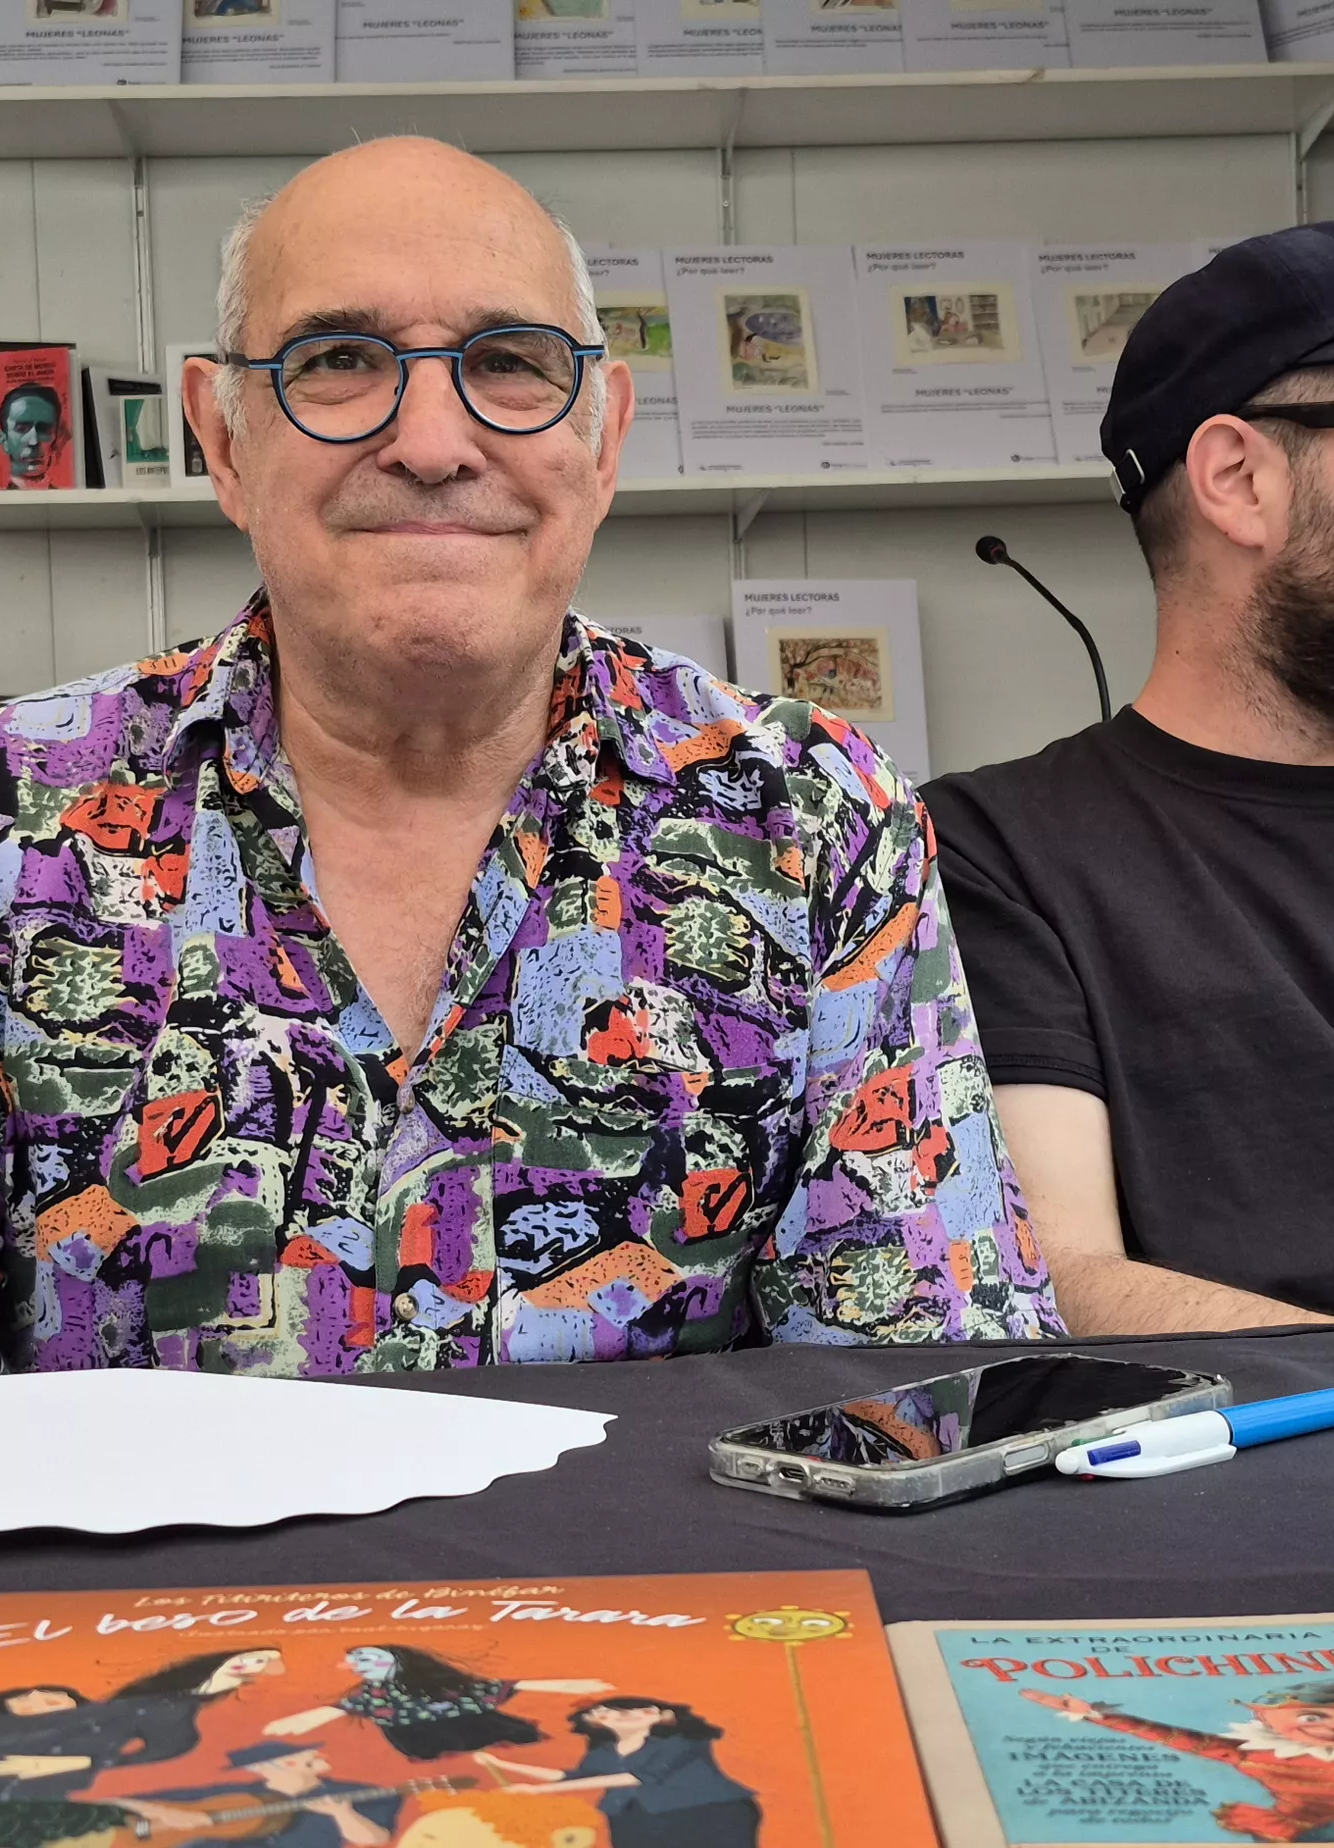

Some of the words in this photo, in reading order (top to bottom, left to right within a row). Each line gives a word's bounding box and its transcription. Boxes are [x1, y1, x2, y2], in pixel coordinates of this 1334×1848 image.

[201, 1589, 370, 1609] Titiriteros
[375, 1588, 414, 1602] de
[96, 1606, 259, 1636] beso
[283, 1600, 372, 1623] de
[391, 1599, 468, 1621] la
[490, 1599, 708, 1629] Tarara
[971, 1635, 1011, 1645] LA
[1026, 1631, 1322, 1645] EXTRAORDINARIA
[1091, 1645, 1132, 1653] DE
[1009, 1751, 1181, 1762] IMAGENES
[1024, 1778, 1061, 1787] LA
[1071, 1778, 1145, 1787] CASA
[1154, 1779, 1191, 1788] DE
[1017, 1787, 1072, 1796] LOS
